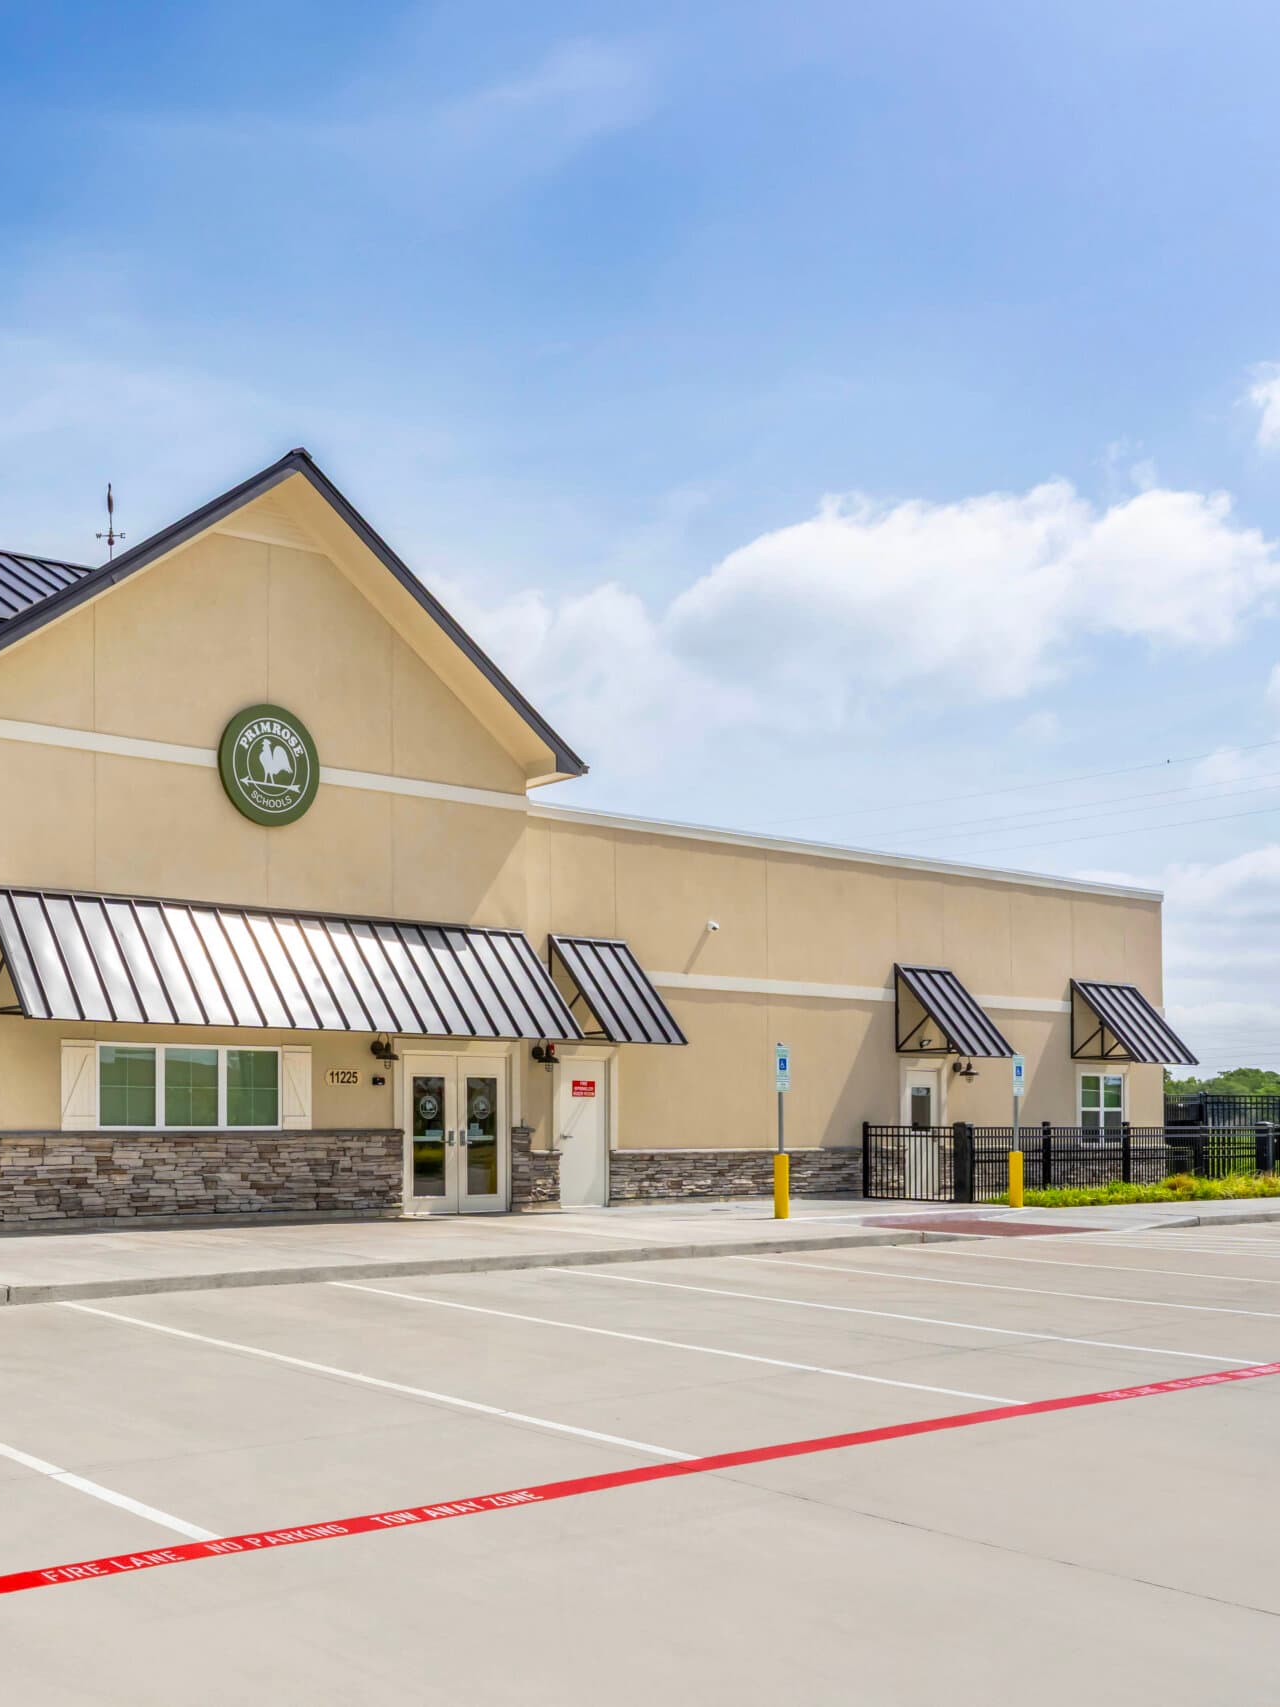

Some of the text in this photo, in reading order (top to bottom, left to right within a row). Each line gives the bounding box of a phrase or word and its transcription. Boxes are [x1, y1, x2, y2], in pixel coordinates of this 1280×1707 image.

[239, 721, 304, 757] PRIMROSE
[250, 790, 292, 808] SCHOOLS
[329, 1071, 358, 1084] 11225
[41, 1490, 544, 1582] FIRE LANE NO PARKING TOW AWAY ZONE
